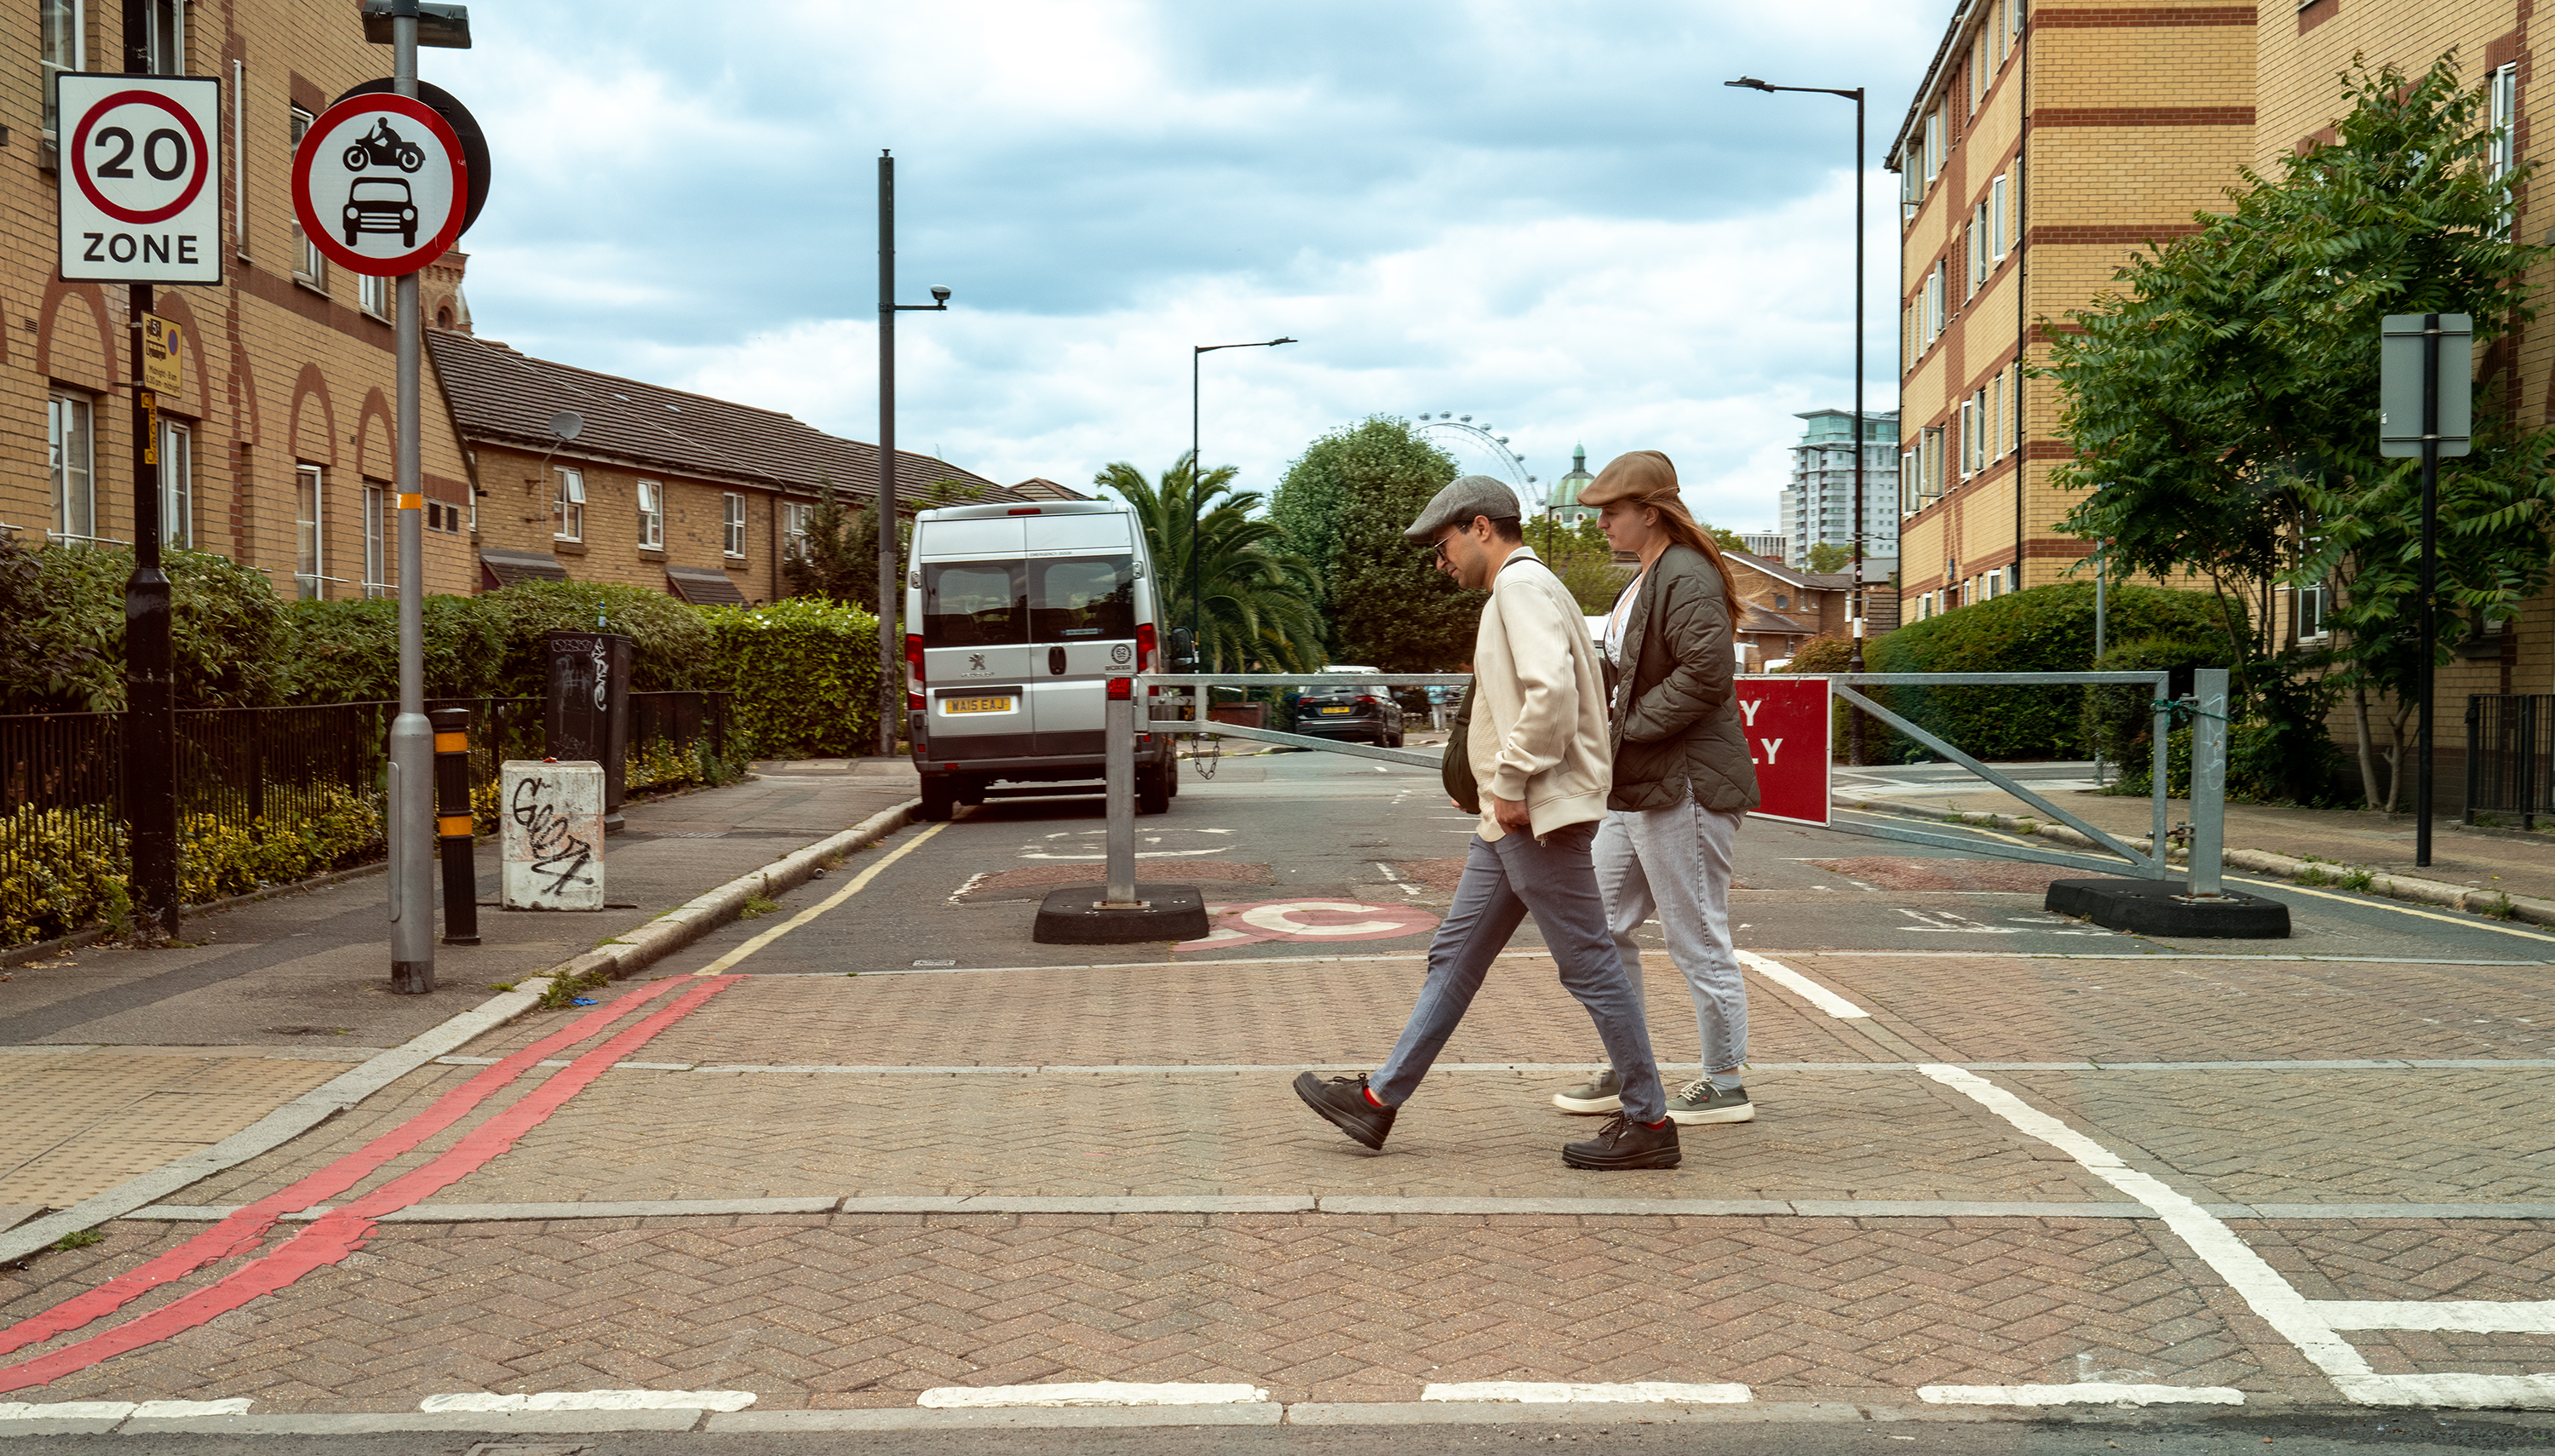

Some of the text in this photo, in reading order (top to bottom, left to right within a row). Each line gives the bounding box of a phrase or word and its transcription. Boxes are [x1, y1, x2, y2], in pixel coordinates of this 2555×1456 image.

[95, 126, 187, 181] 20
[83, 232, 198, 264] ZONE
[952, 699, 1004, 711] WA15 EAJ
